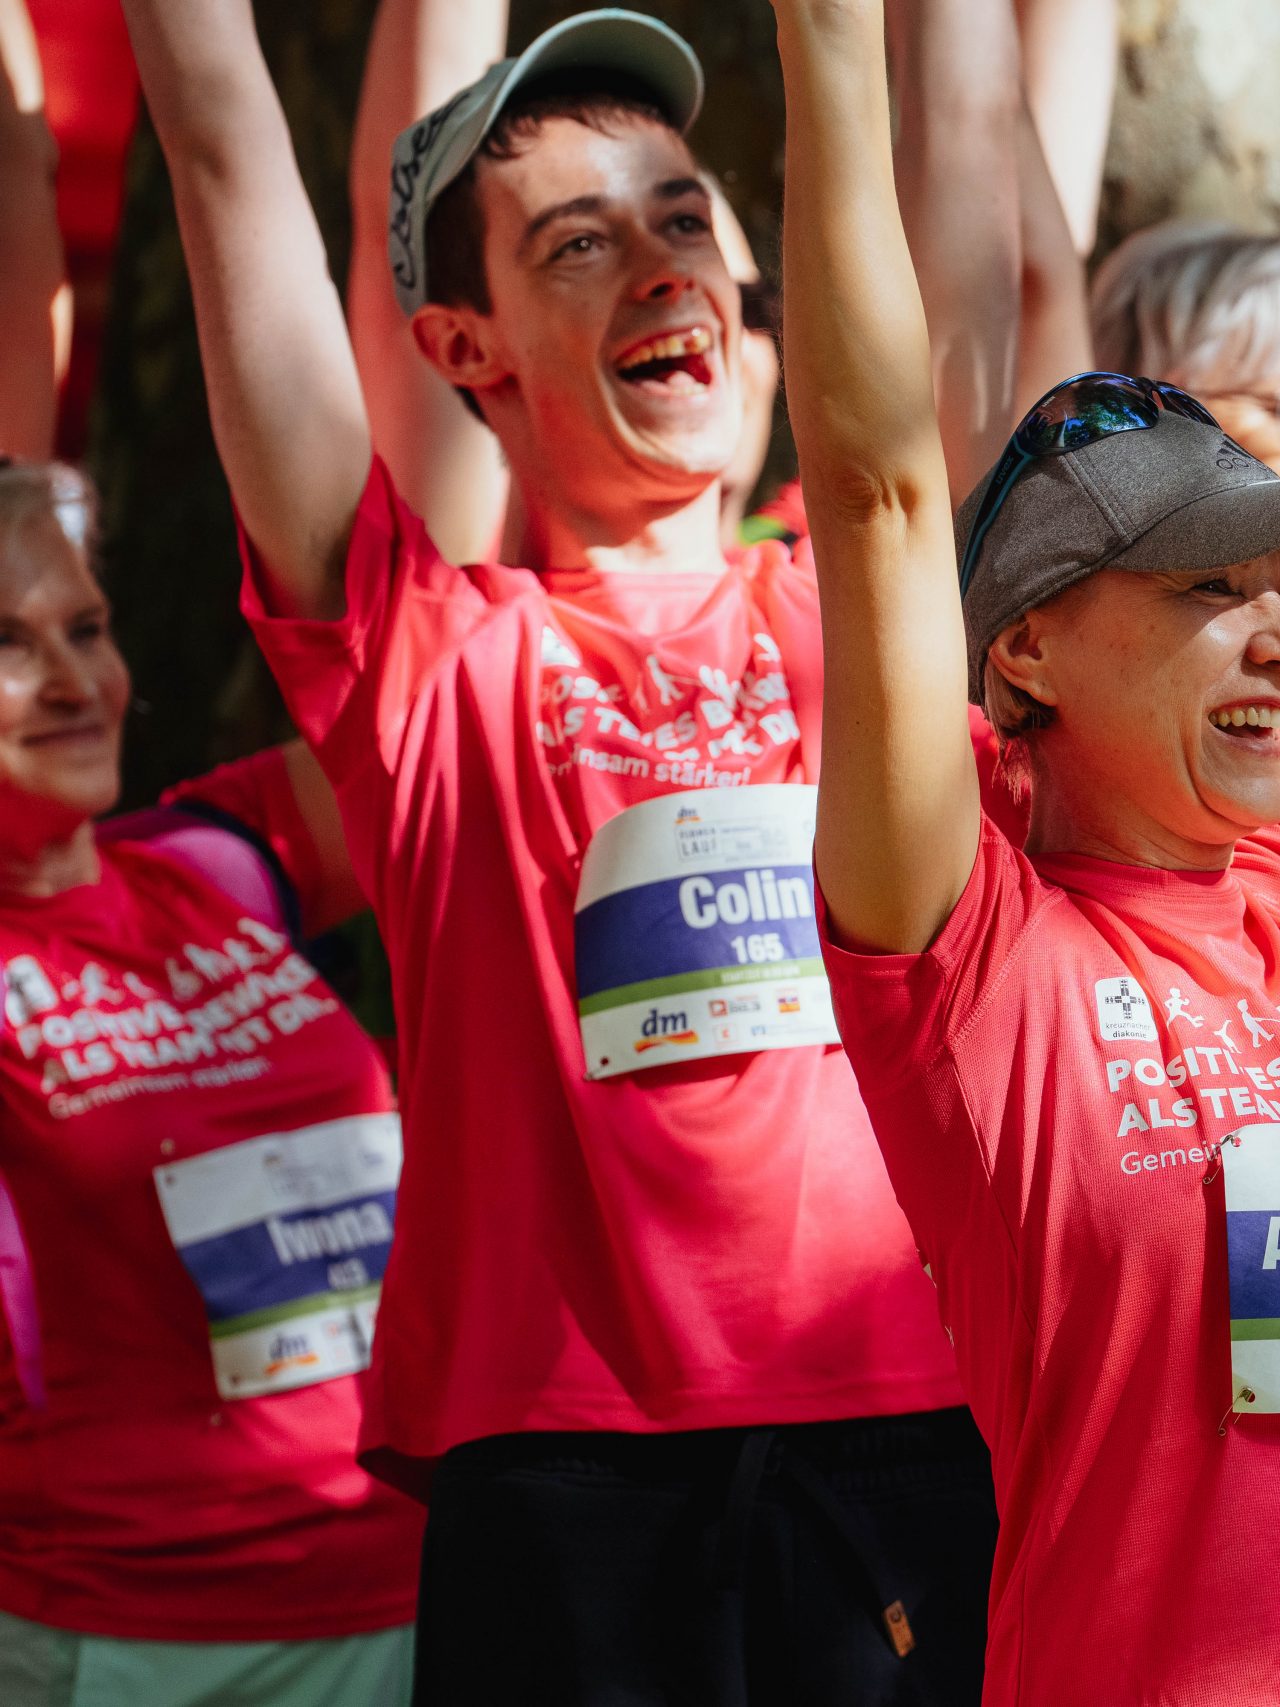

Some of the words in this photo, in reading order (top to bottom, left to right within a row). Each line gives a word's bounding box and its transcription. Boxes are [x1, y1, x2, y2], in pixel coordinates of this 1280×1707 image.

[679, 869, 812, 930] Colin
[730, 932, 785, 964] 165
[642, 1008, 688, 1036] dm
[1112, 1030, 1147, 1038] diakonie
[1117, 1097, 1198, 1137] ALS
